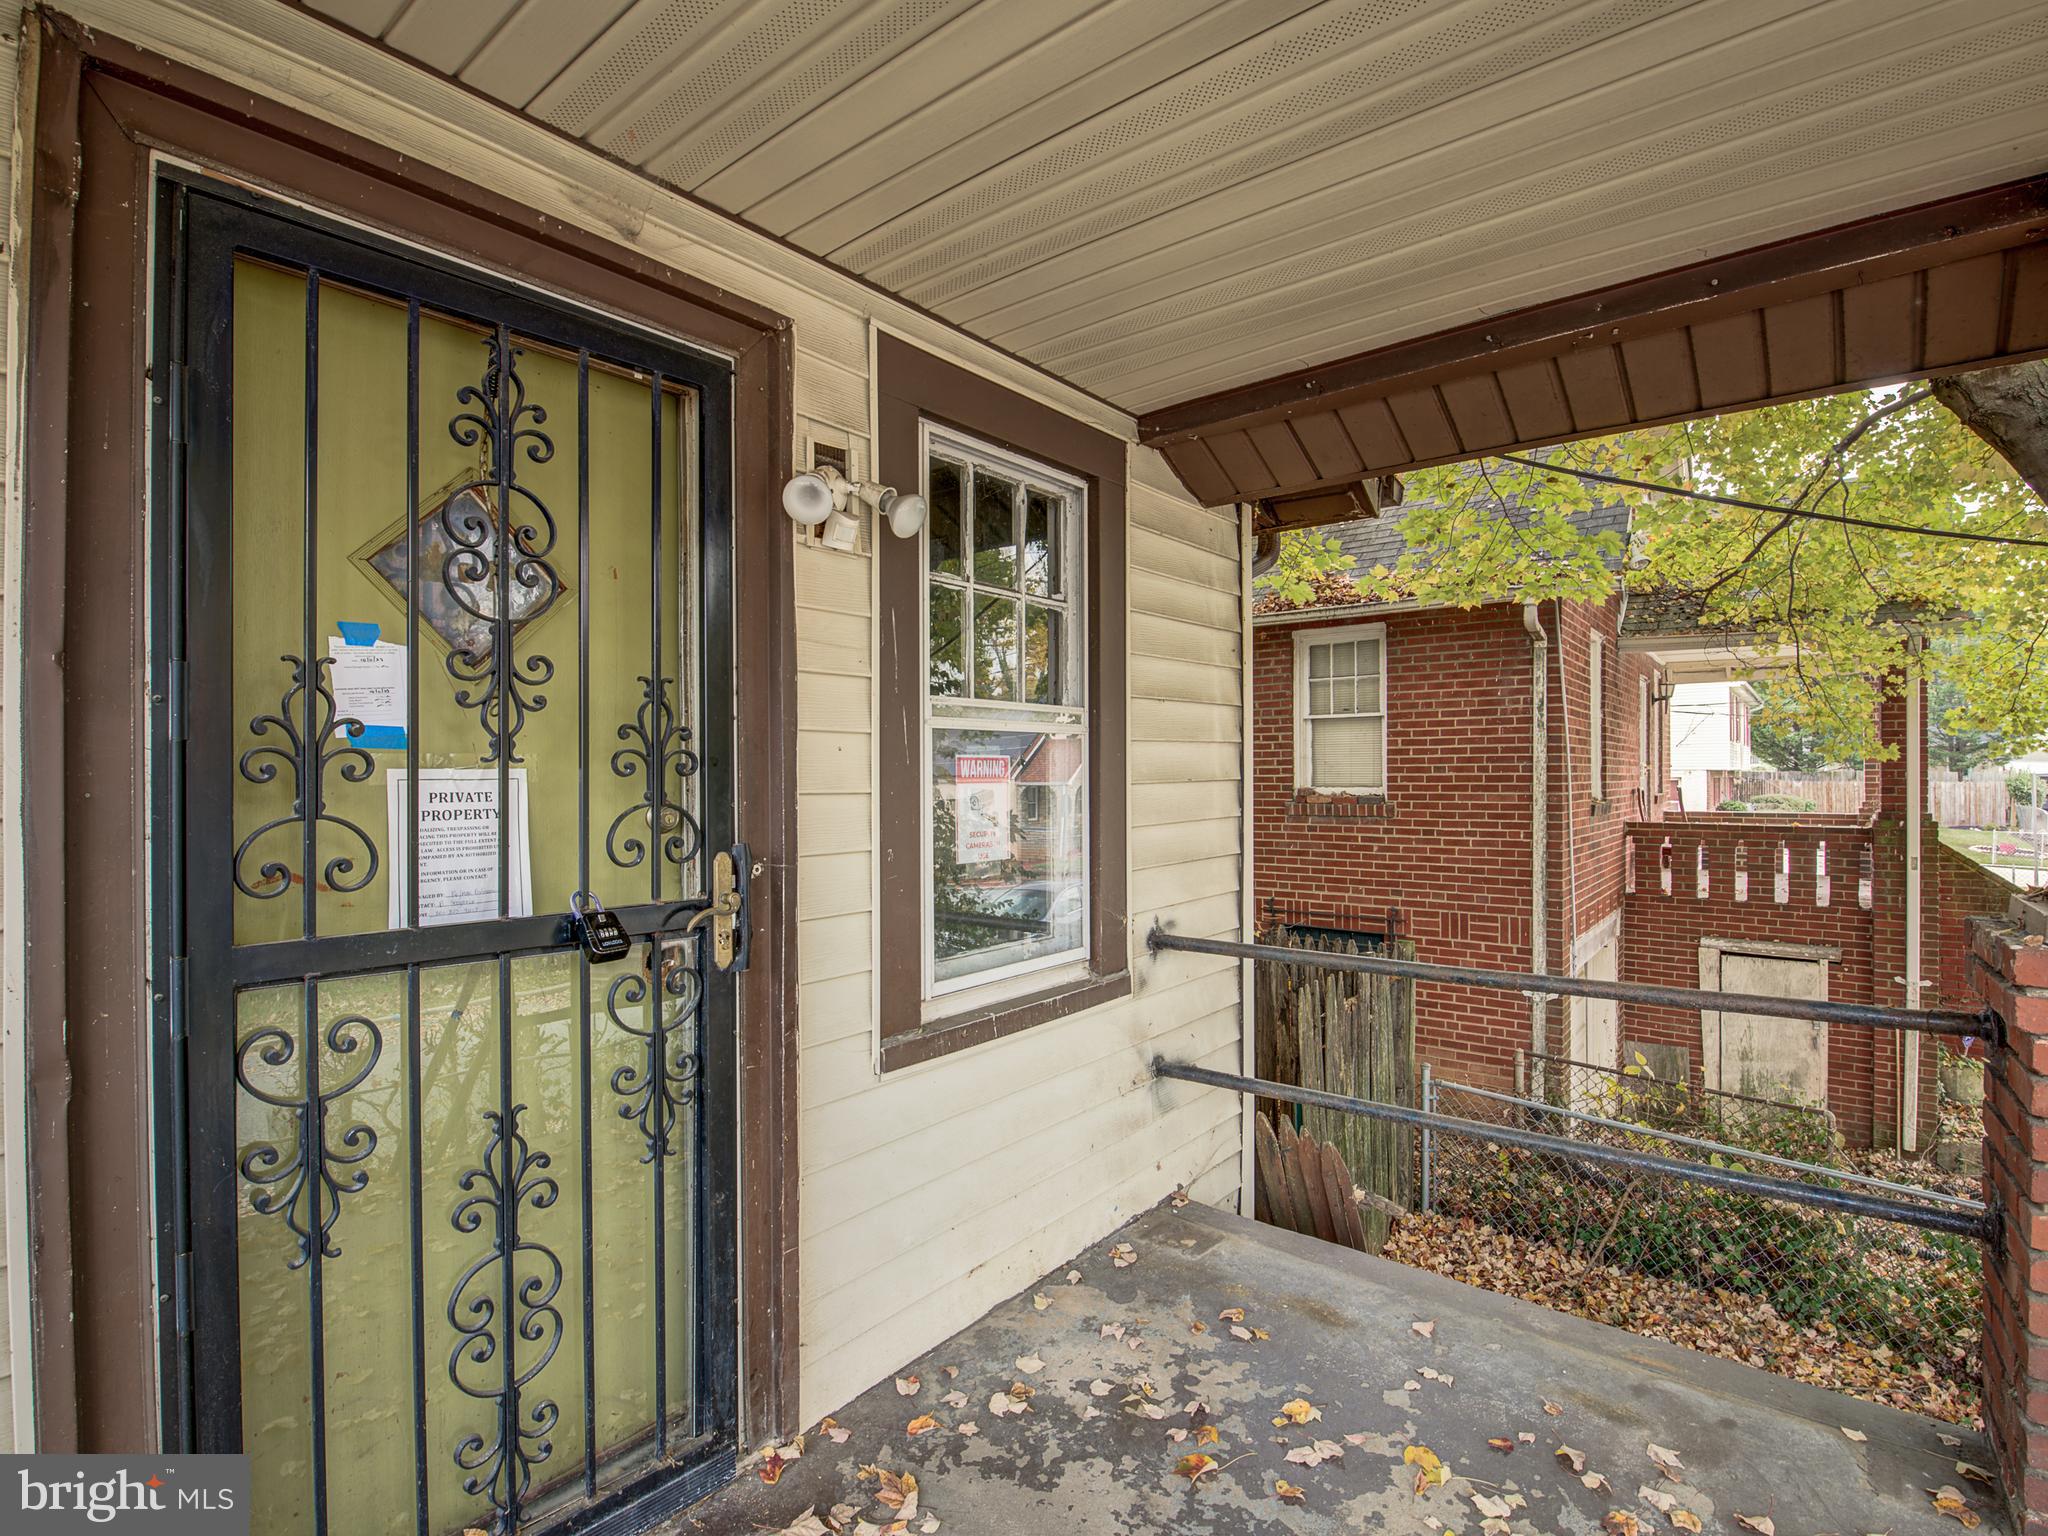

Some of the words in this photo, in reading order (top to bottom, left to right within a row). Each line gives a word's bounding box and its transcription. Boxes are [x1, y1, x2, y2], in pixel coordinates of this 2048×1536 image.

[960, 759, 1005, 779] WARNING
[429, 791, 493, 804] PRIVATE
[421, 809, 500, 822] PROPERTY
[965, 841, 993, 849] CAMERAS
